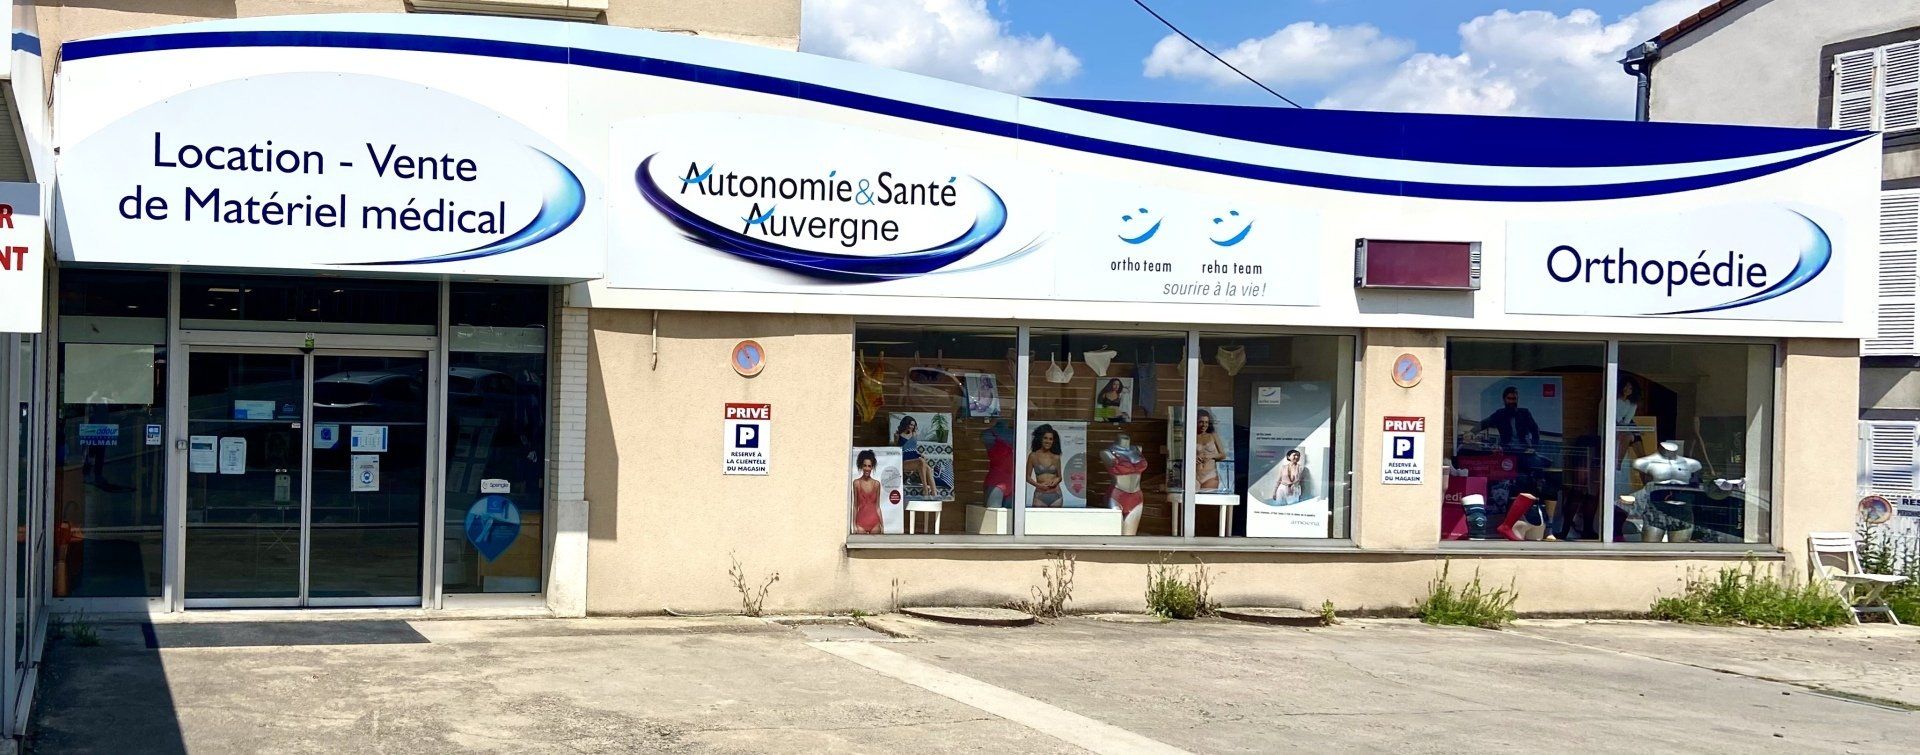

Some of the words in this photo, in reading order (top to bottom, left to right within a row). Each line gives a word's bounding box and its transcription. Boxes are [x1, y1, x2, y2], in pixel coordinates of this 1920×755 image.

[154, 131, 325, 175] Location
[339, 160, 354, 168] -
[366, 142, 478, 182] Vente
[118, 184, 169, 220] de
[184, 186, 347, 228] Matériel
[362, 197, 506, 235] médical
[740, 202, 900, 248] Auvergne
[1202, 259, 1228, 274] reha
[1233, 262, 1263, 275] team
[1546, 244, 1768, 298] Orthopédie
[1163, 281, 1210, 296] sourire
[1213, 281, 1222, 296] à
[1225, 282, 1237, 297] la
[726, 405, 769, 419] PRIVÉ
[1385, 418, 1424, 431] PRIVÉ
[739, 426, 755, 445] P
[1396, 438, 1411, 456] P
